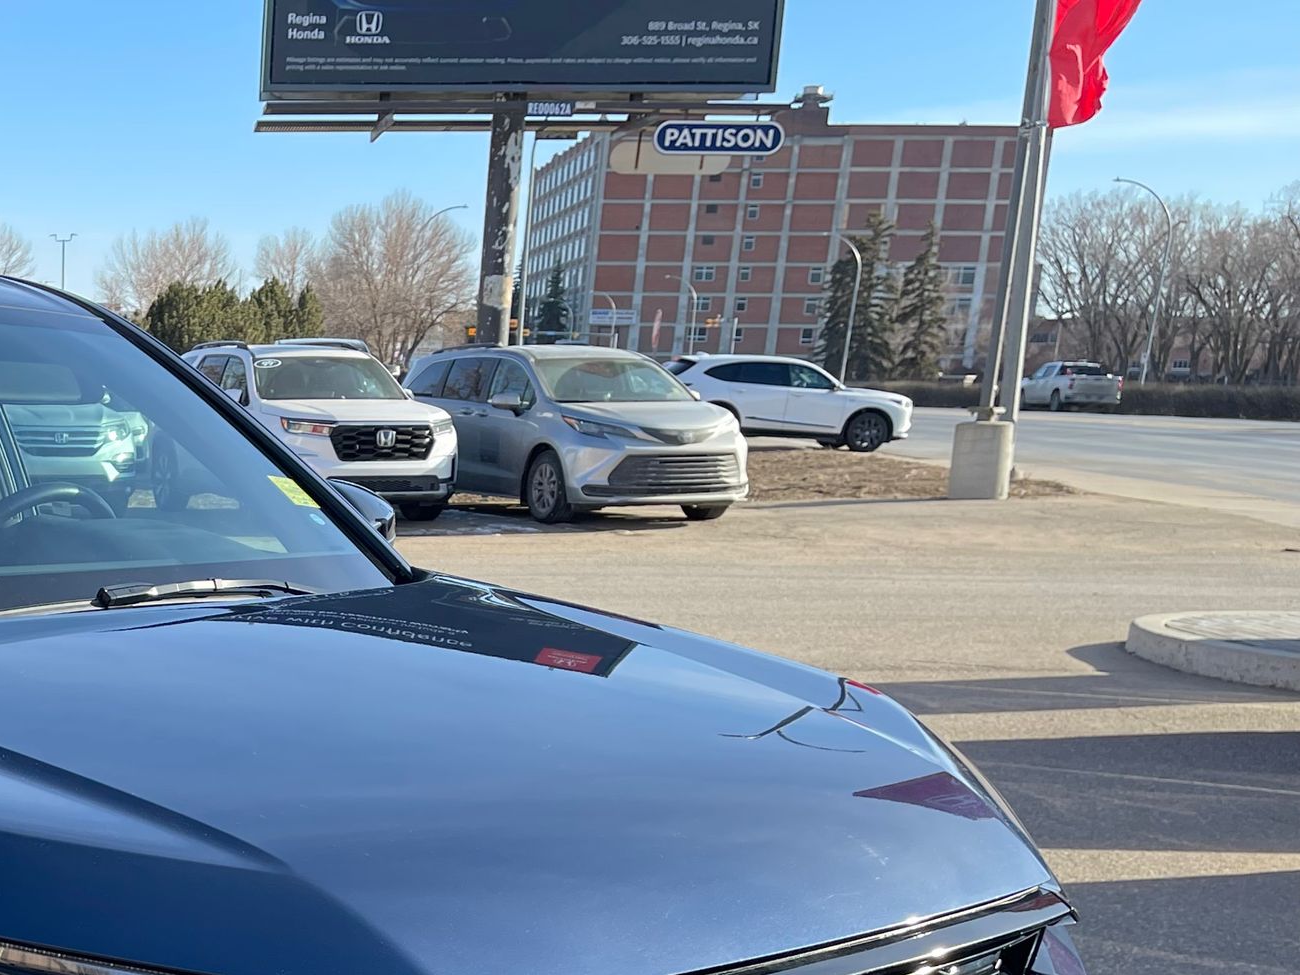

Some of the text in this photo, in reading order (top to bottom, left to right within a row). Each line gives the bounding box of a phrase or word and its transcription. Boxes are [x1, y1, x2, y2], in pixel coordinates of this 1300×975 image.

[287, 12, 327, 26] Regina
[667, 21, 695, 31] Broad
[747, 21, 760, 30] SK
[287, 28, 325, 39] Honda
[345, 36, 390, 44] HONDA
[527, 102, 572, 116] RE00062A
[663, 128, 775, 149] PATTISON
